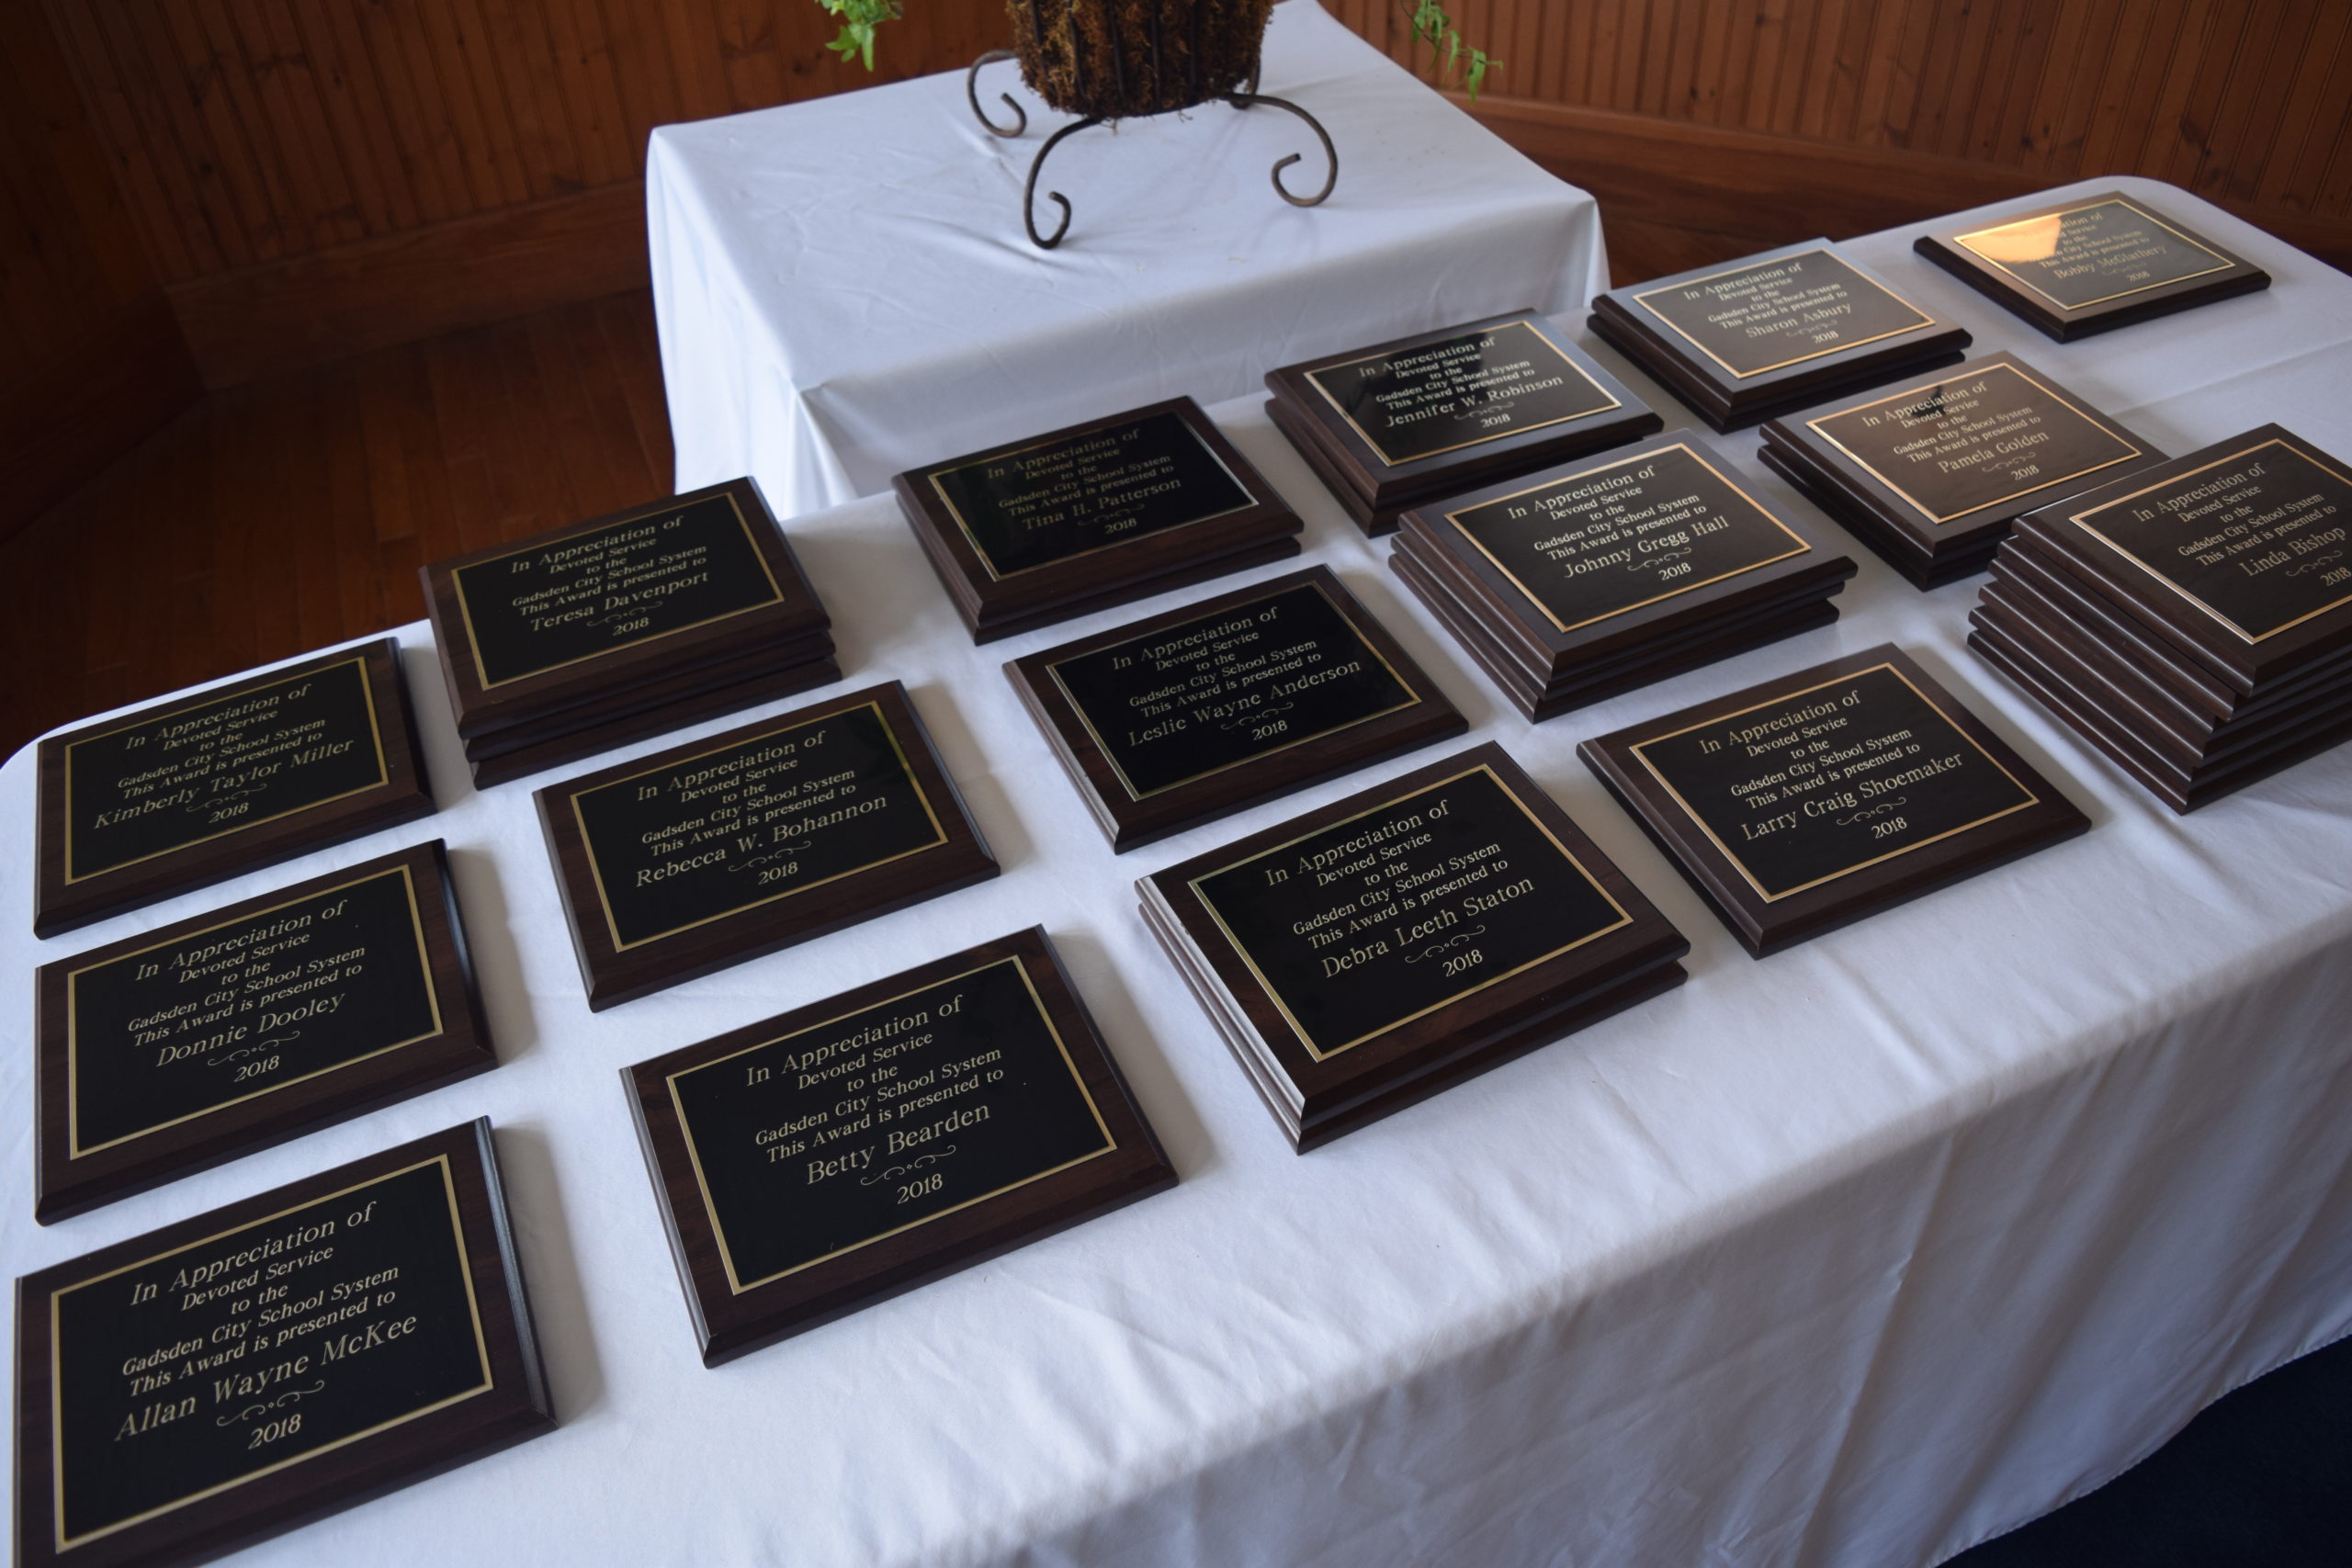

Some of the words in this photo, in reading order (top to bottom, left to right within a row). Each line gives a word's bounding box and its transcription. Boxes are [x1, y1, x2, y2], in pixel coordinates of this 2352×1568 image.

[1681, 290, 1701, 299] In
[1704, 268, 1786, 295] Appreciation
[1787, 261, 1803, 273] of
[2125, 269, 2151, 282] 2018
[1744, 317, 1799, 338] Sharon
[1802, 302, 1851, 323] Asbury
[1811, 330, 1839, 344] 2018
[1357, 367, 1376, 377] In
[1381, 343, 1476, 372] Appreciation
[1478, 335, 1496, 347] of
[1386, 401, 1455, 427] Jennifer
[1459, 393, 1483, 407] W.
[1485, 376, 1564, 401] Robinson
[1479, 412, 1511, 428] 2018
[1860, 415, 1882, 427] In
[1883, 389, 1971, 421] Appreciation
[1971, 380, 1988, 393] of
[986, 467, 1005, 479] In
[1011, 436, 1116, 472] Appreciation
[1121, 427, 1140, 441] of
[1936, 448, 1996, 473] Pamela
[1995, 431, 2050, 454] Golden
[2009, 464, 2040, 480] 2018
[1021, 512, 1065, 530] Tina
[1071, 502, 1091, 516] H.
[1097, 478, 1182, 510] Patterson
[1506, 506, 1528, 519] In
[1533, 474, 1634, 512] Appreciation
[1637, 464, 1656, 479] of
[1548, 498, 1599, 520] Devoted
[1599, 486, 1643, 504] Service
[1588, 512, 1603, 521] to
[1604, 504, 1625, 516] the
[2131, 508, 2155, 522] In
[2155, 472, 2248, 513] Appreciation
[2247, 461, 2267, 477] of
[510, 560, 530, 573] In
[537, 525, 655, 566] Appreciation
[662, 514, 684, 529] of
[1103, 516, 1137, 535] 2018
[1532, 530, 1586, 551] Gadsden
[1586, 521, 1611, 535] City
[1613, 505, 1657, 526] School
[1656, 494, 1701, 513] System
[1545, 546, 1577, 560] This
[1579, 530, 1620, 551] Award
[1620, 527, 1634, 537] is
[1634, 508, 1691, 535] presented
[1691, 505, 1707, 514] to
[1564, 547, 1631, 578] Johnny
[1636, 530, 1690, 553] Gregg
[1690, 514, 1729, 536] Hall
[2177, 533, 2226, 557] Gadsden
[2222, 523, 2249, 537] City
[2246, 506, 2287, 528] School
[2283, 493, 2325, 513] System
[2194, 550, 2225, 566] This
[2223, 533, 2263, 556] Award
[2258, 530, 2275, 540] is
[2272, 508, 2324, 536] presented
[2321, 504, 2336, 514] to
[1657, 561, 1692, 581] 2018
[2237, 549, 2292, 577] Linda
[2287, 526, 2346, 556] Bishop
[2319, 565, 2352, 586] 2018
[529, 605, 594, 631] Teresa
[604, 570, 707, 611] Davenport
[612, 615, 650, 637] 2018
[1111, 656, 1133, 670] In
[1139, 617, 1253, 661] Appreciation
[1259, 605, 1278, 622] of
[124, 735, 146, 750] In
[153, 694, 280, 741] Appreciation
[287, 682, 311, 700] of
[1127, 717, 1187, 747] Leslie
[1192, 693, 1261, 723] Wayne
[1270, 660, 1361, 699] Anderson
[1250, 718, 1288, 741] 2018
[1698, 739, 1722, 754] In
[1728, 701, 1838, 746] Appreciation
[1841, 689, 1861, 706] of
[94, 786, 199, 829] Kimberly
[209, 761, 282, 793] Taylor
[289, 739, 354, 768] Miller
[637, 785, 658, 801] In
[666, 742, 796, 792] Appreciation
[803, 728, 826, 748] of
[208, 801, 249, 824] 2018
[1740, 810, 1796, 840] Larry
[1803, 791, 1858, 818] Craig
[1858, 752, 1962, 798] Shoemaker
[636, 848, 726, 887] Rebecca
[736, 832, 763, 852] W.
[773, 795, 887, 842] Bohannon
[1264, 867, 1290, 886] In
[1297, 814, 1423, 874] Appreciation
[1428, 798, 1450, 819] of
[1870, 816, 1908, 839] 2018
[757, 860, 798, 885] 2018
[1315, 852, 1377, 886] Devoted
[1378, 832, 1432, 861] Service
[1363, 873, 1381, 886] to
[1383, 861, 1408, 878] the
[1292, 902, 1357, 935] Gadsden
[1359, 886, 1390, 907] City
[1394, 862, 1446, 893] School
[1447, 842, 1501, 871] System
[1306, 928, 1344, 949] This
[1349, 901, 1399, 934] Award
[1400, 897, 1417, 910] is
[1419, 863, 1488, 906] presented
[1490, 859, 1509, 873] to
[134, 963, 159, 981] In
[167, 913, 311, 970] Appreciation
[321, 897, 348, 919] of
[1320, 940, 1389, 978] Debra
[1394, 908, 1458, 946] Leeth
[1462, 877, 1534, 917] Staton
[1442, 948, 1484, 977] 2018
[155, 1024, 248, 1066] Donnie
[256, 992, 345, 1033] Dooley
[746, 1066, 771, 1087] In
[780, 1010, 929, 1074] Appreciation
[937, 993, 964, 1017] of
[232, 1054, 280, 1082] 2018
[807, 1145, 876, 1185] Betty
[887, 1104, 989, 1155] Bearden
[897, 1172, 944, 1204] 2018
[130, 1281, 158, 1306] In
[167, 1220, 335, 1292] Appreciation
[345, 1200, 378, 1227] of
[180, 1268, 259, 1311] Devoted
[264, 1246, 334, 1280] Service
[121, 1337, 203, 1376] Gadsden
[210, 1318, 252, 1344] City
[256, 1289, 324, 1327] School
[330, 1266, 399, 1301] System
[230, 1298, 251, 1315] to
[257, 1284, 288, 1305] the
[130, 1370, 172, 1397] This
[177, 1339, 246, 1380] Award
[252, 1334, 269, 1353] is
[275, 1295, 368, 1347] presented
[376, 1290, 396, 1307] to
[115, 1395, 196, 1440] Allan
[213, 1355, 310, 1404] Wayne
[320, 1315, 417, 1366] McKee
[247, 1412, 301, 1450] 2018
